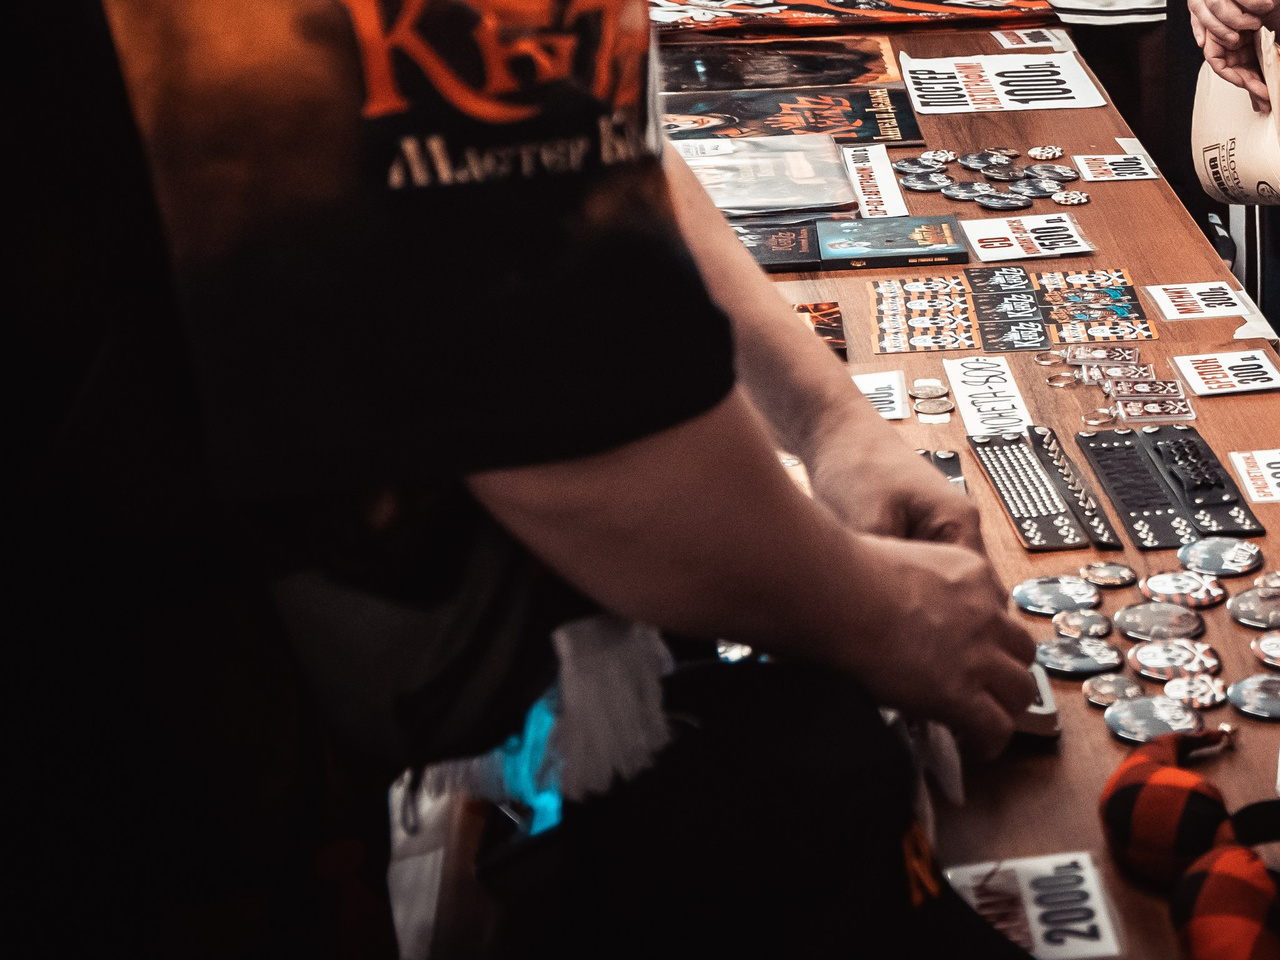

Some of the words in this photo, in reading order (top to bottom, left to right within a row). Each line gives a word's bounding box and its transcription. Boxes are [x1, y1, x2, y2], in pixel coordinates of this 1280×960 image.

[909, 69, 969, 106] ПОСТЕР
[976, 236, 1014, 249] CD
[1030, 225, 1079, 251] 1500
[1161, 286, 1204, 314] МАГНИТ
[1188, 357, 1237, 390] БРЕЛОК
